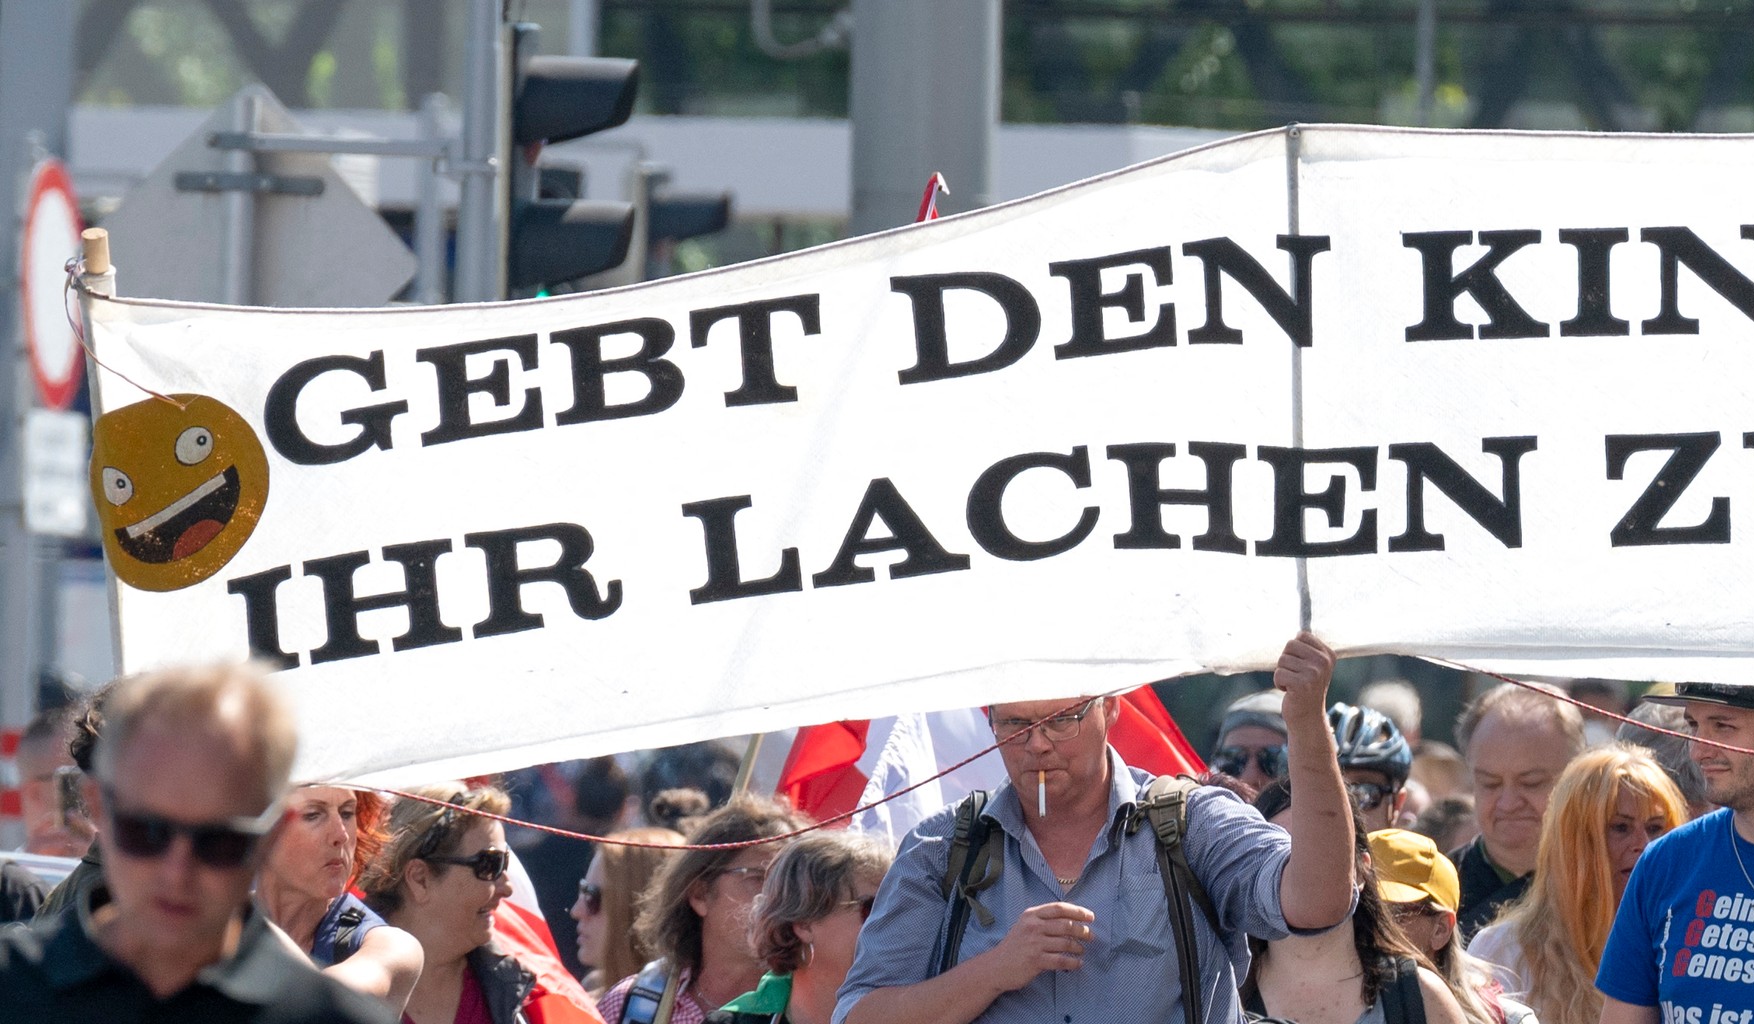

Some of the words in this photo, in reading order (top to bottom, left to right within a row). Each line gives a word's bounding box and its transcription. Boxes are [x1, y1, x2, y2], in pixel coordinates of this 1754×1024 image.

[265, 294, 821, 466] GEBT
[890, 234, 1331, 386] DEN
[228, 522, 624, 670] IHR
[681, 435, 1538, 606] LACHEN
